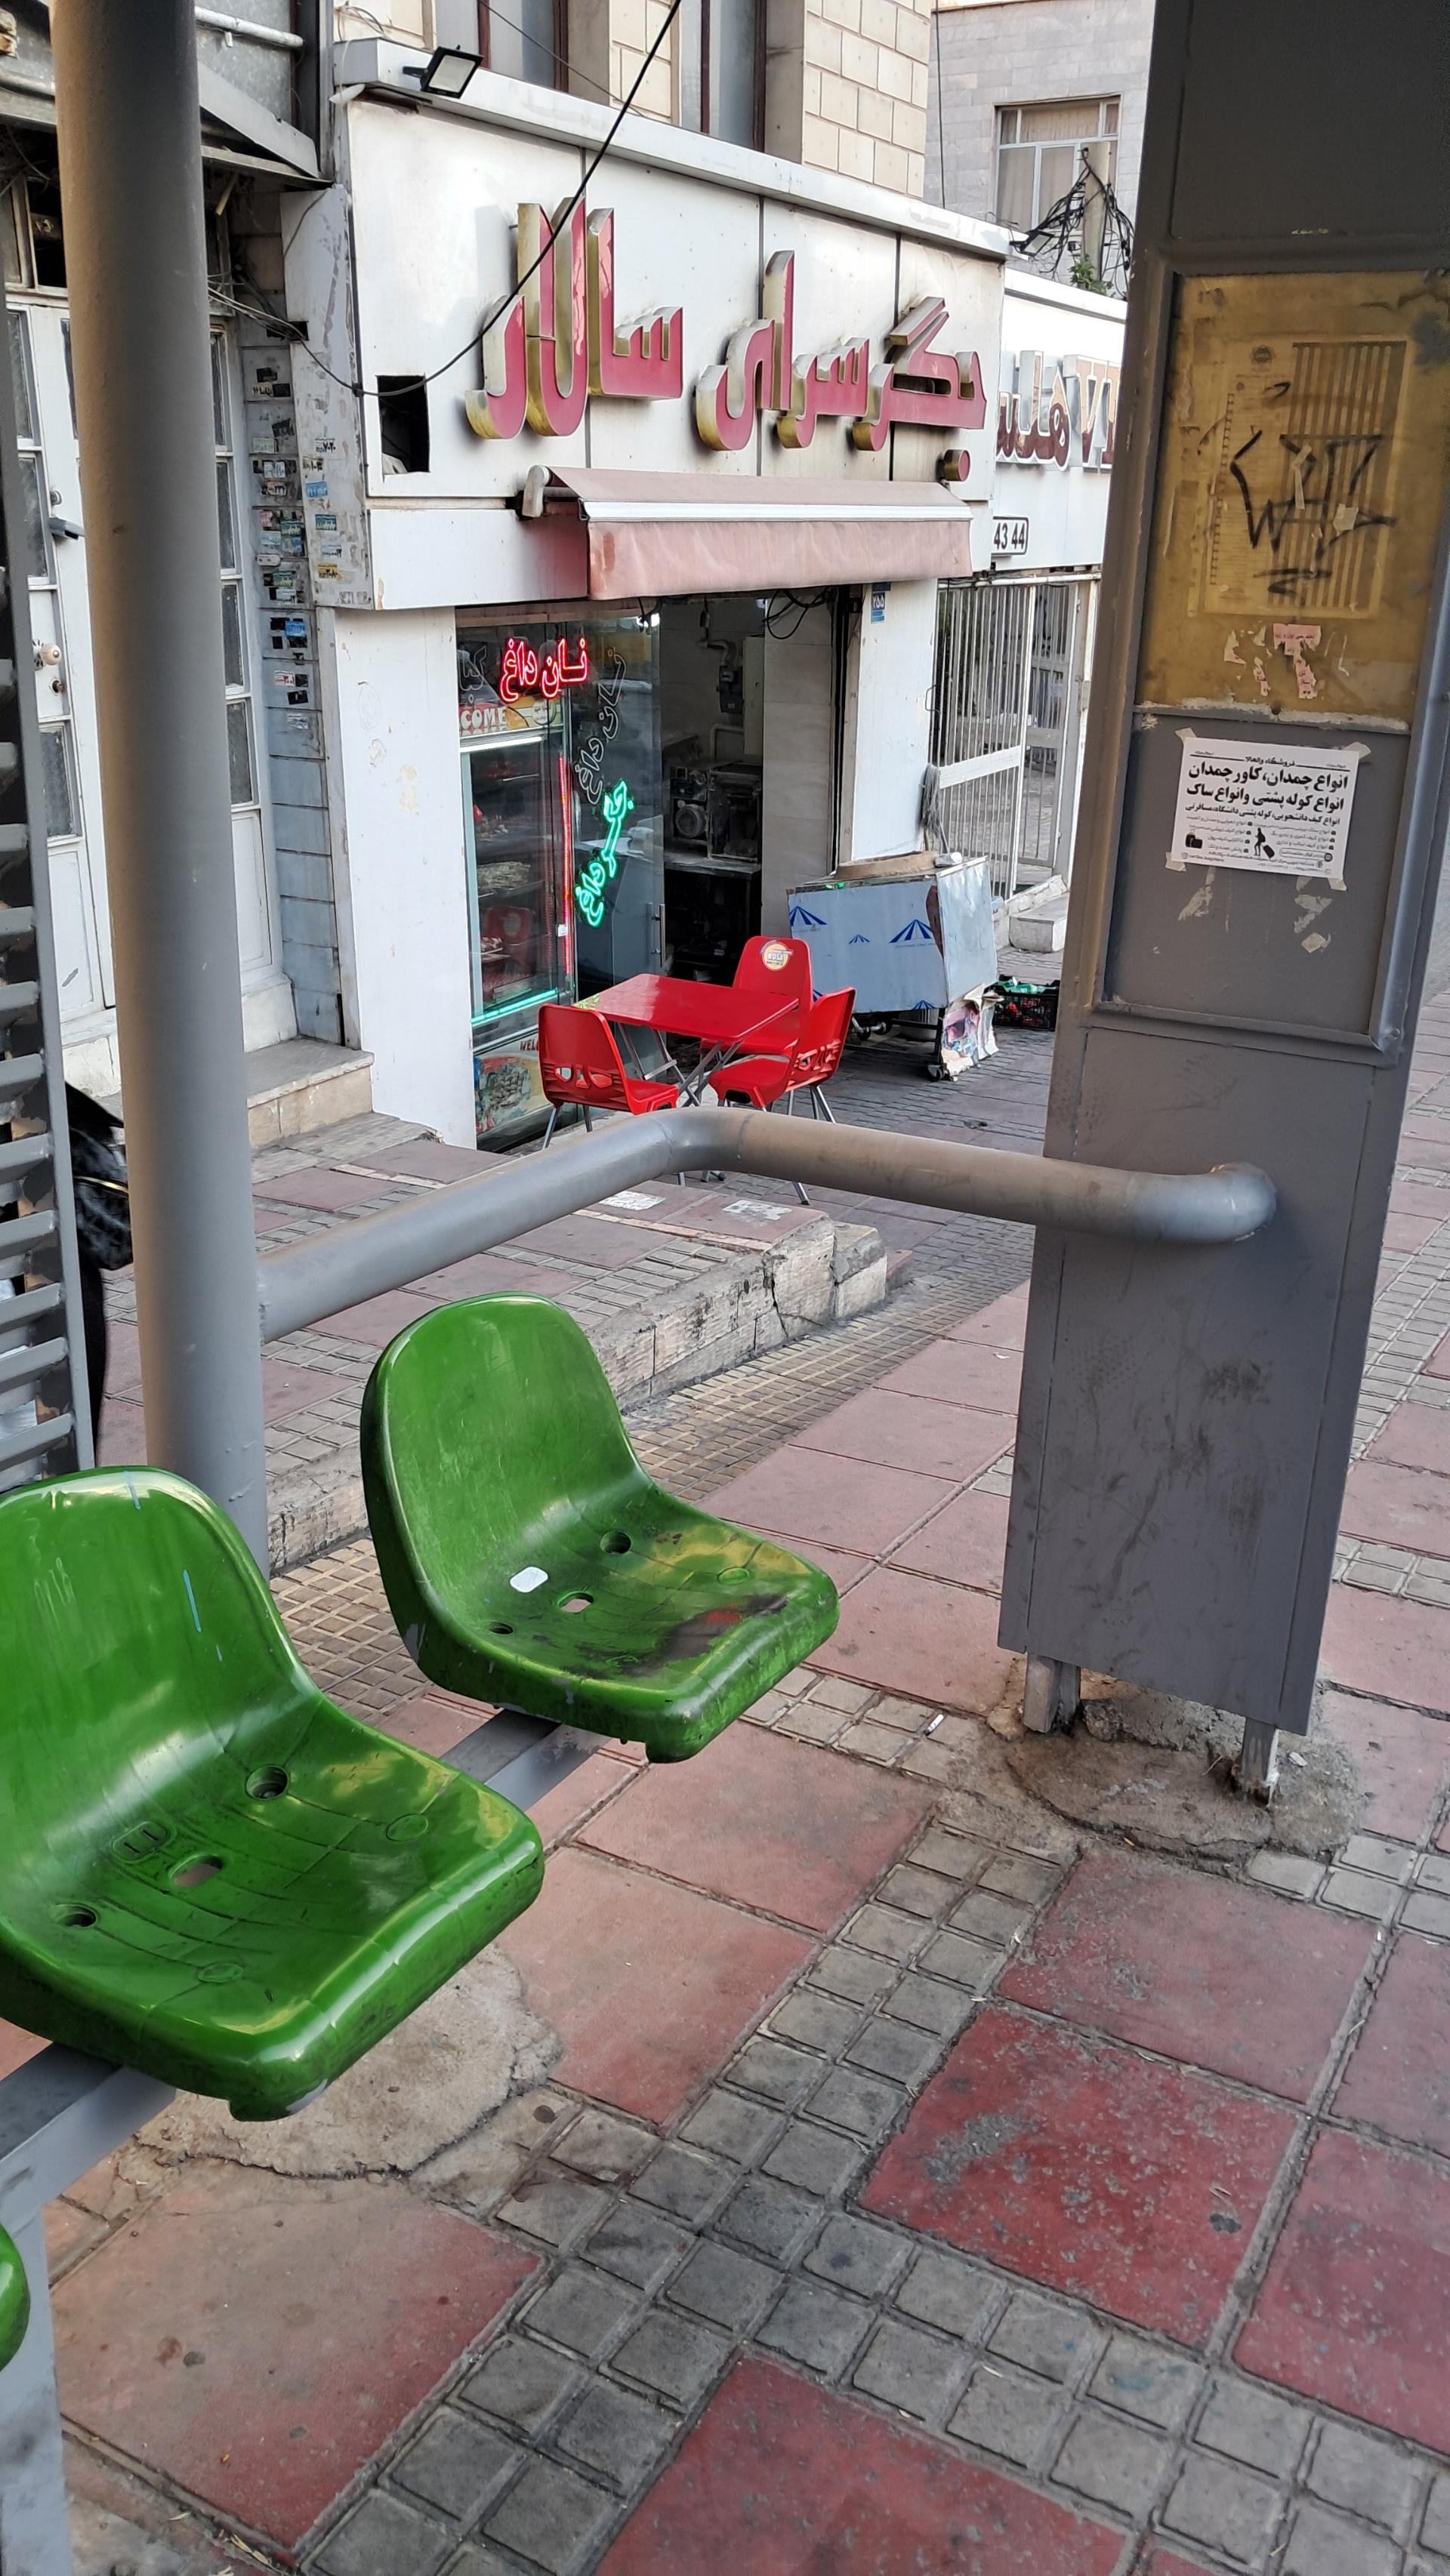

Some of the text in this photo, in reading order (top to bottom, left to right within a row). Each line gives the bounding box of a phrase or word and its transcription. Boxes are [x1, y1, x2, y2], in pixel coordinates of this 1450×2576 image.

[465, 197, 683, 440] سالار
[994, 522, 1025, 550] 43 44
[872, 594, 884, 609] ۲۵۵
[500, 636, 589, 703] نان داغ
[1266, 757, 1295, 767] فروشگاه
[1189, 761, 1232, 782] چمدان
[1232, 766, 1263, 784] کاور
[1186, 783, 1214, 797] ساک
[1313, 773, 1348, 793] انواع
[1252, 791, 1285, 809] پشتی
[1285, 793, 1313, 810] کوله
[1313, 796, 1344, 814] انواع
[1308, 815, 1322, 824] کیف
[1322, 818, 1340, 827] انواع
